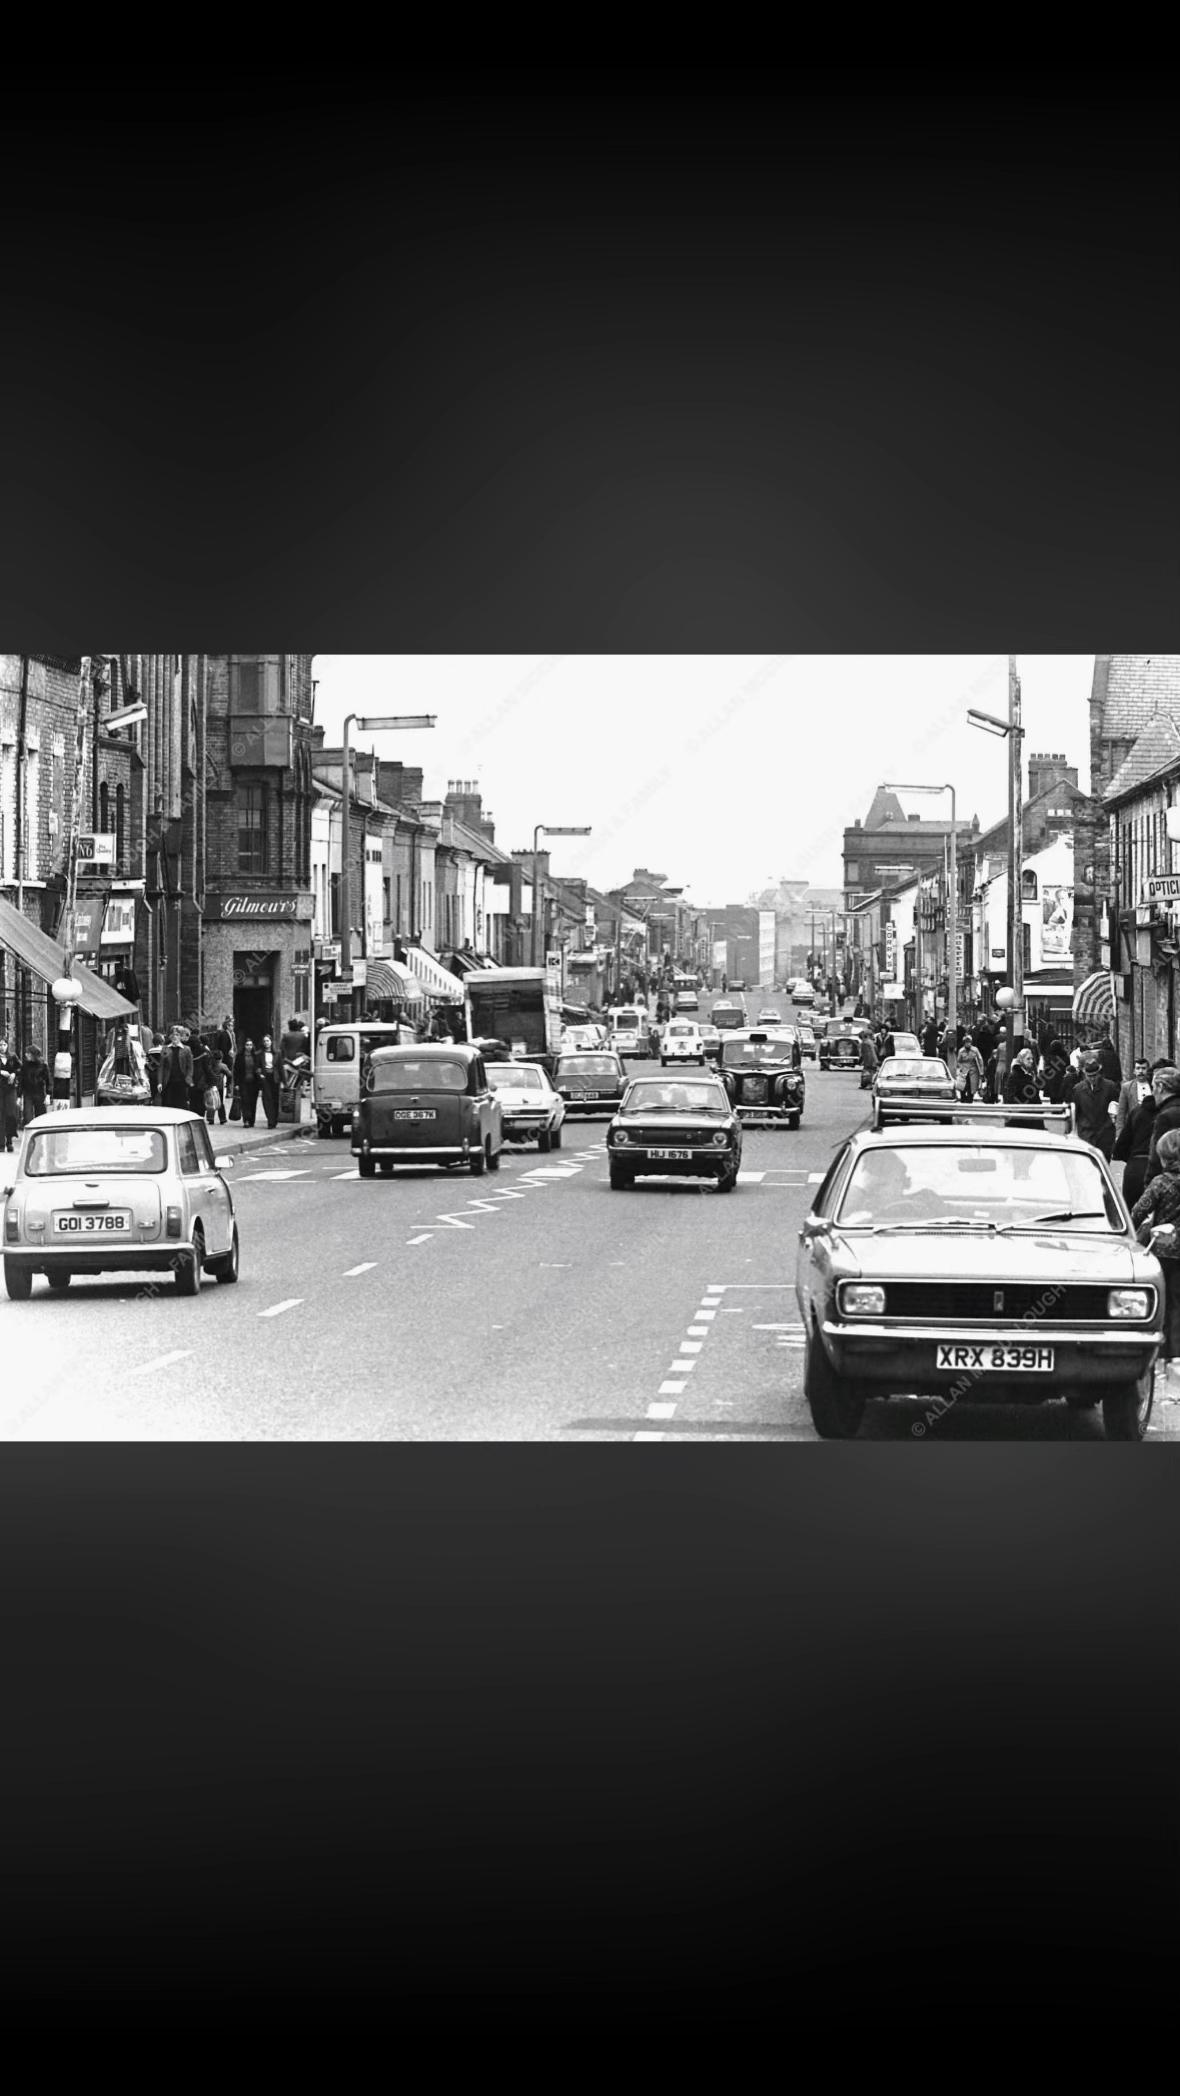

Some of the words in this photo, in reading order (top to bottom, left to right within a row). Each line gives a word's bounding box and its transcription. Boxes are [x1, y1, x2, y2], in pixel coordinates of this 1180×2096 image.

[668, 1150, 689, 1158] 1676
[58, 1217, 82, 1231] GOI
[85, 1216, 124, 1229] 3788
[939, 1346, 984, 1367] XRX
[991, 1348, 1052, 1368] 839H
